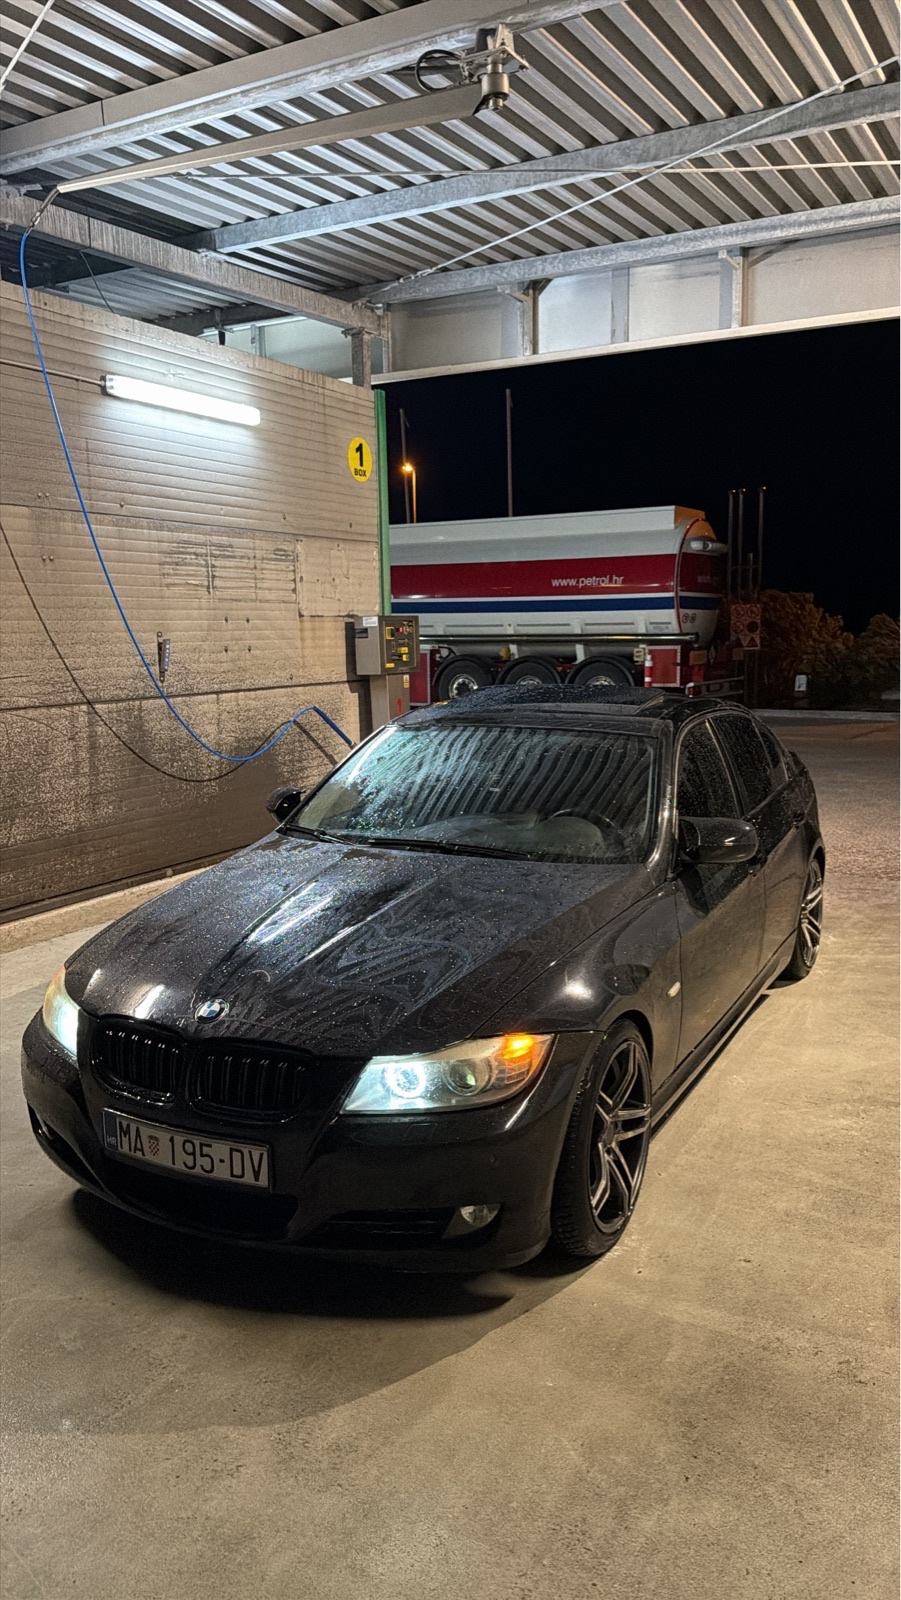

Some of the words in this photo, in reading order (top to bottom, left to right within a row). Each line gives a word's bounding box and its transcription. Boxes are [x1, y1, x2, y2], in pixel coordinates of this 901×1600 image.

[355, 442, 364, 468] 1
[354, 468, 367, 478] BOX
[551, 575, 625, 589] www.petrol.hr
[118, 1120, 146, 1157] MA
[168, 1135, 265, 1183] 195-DV
